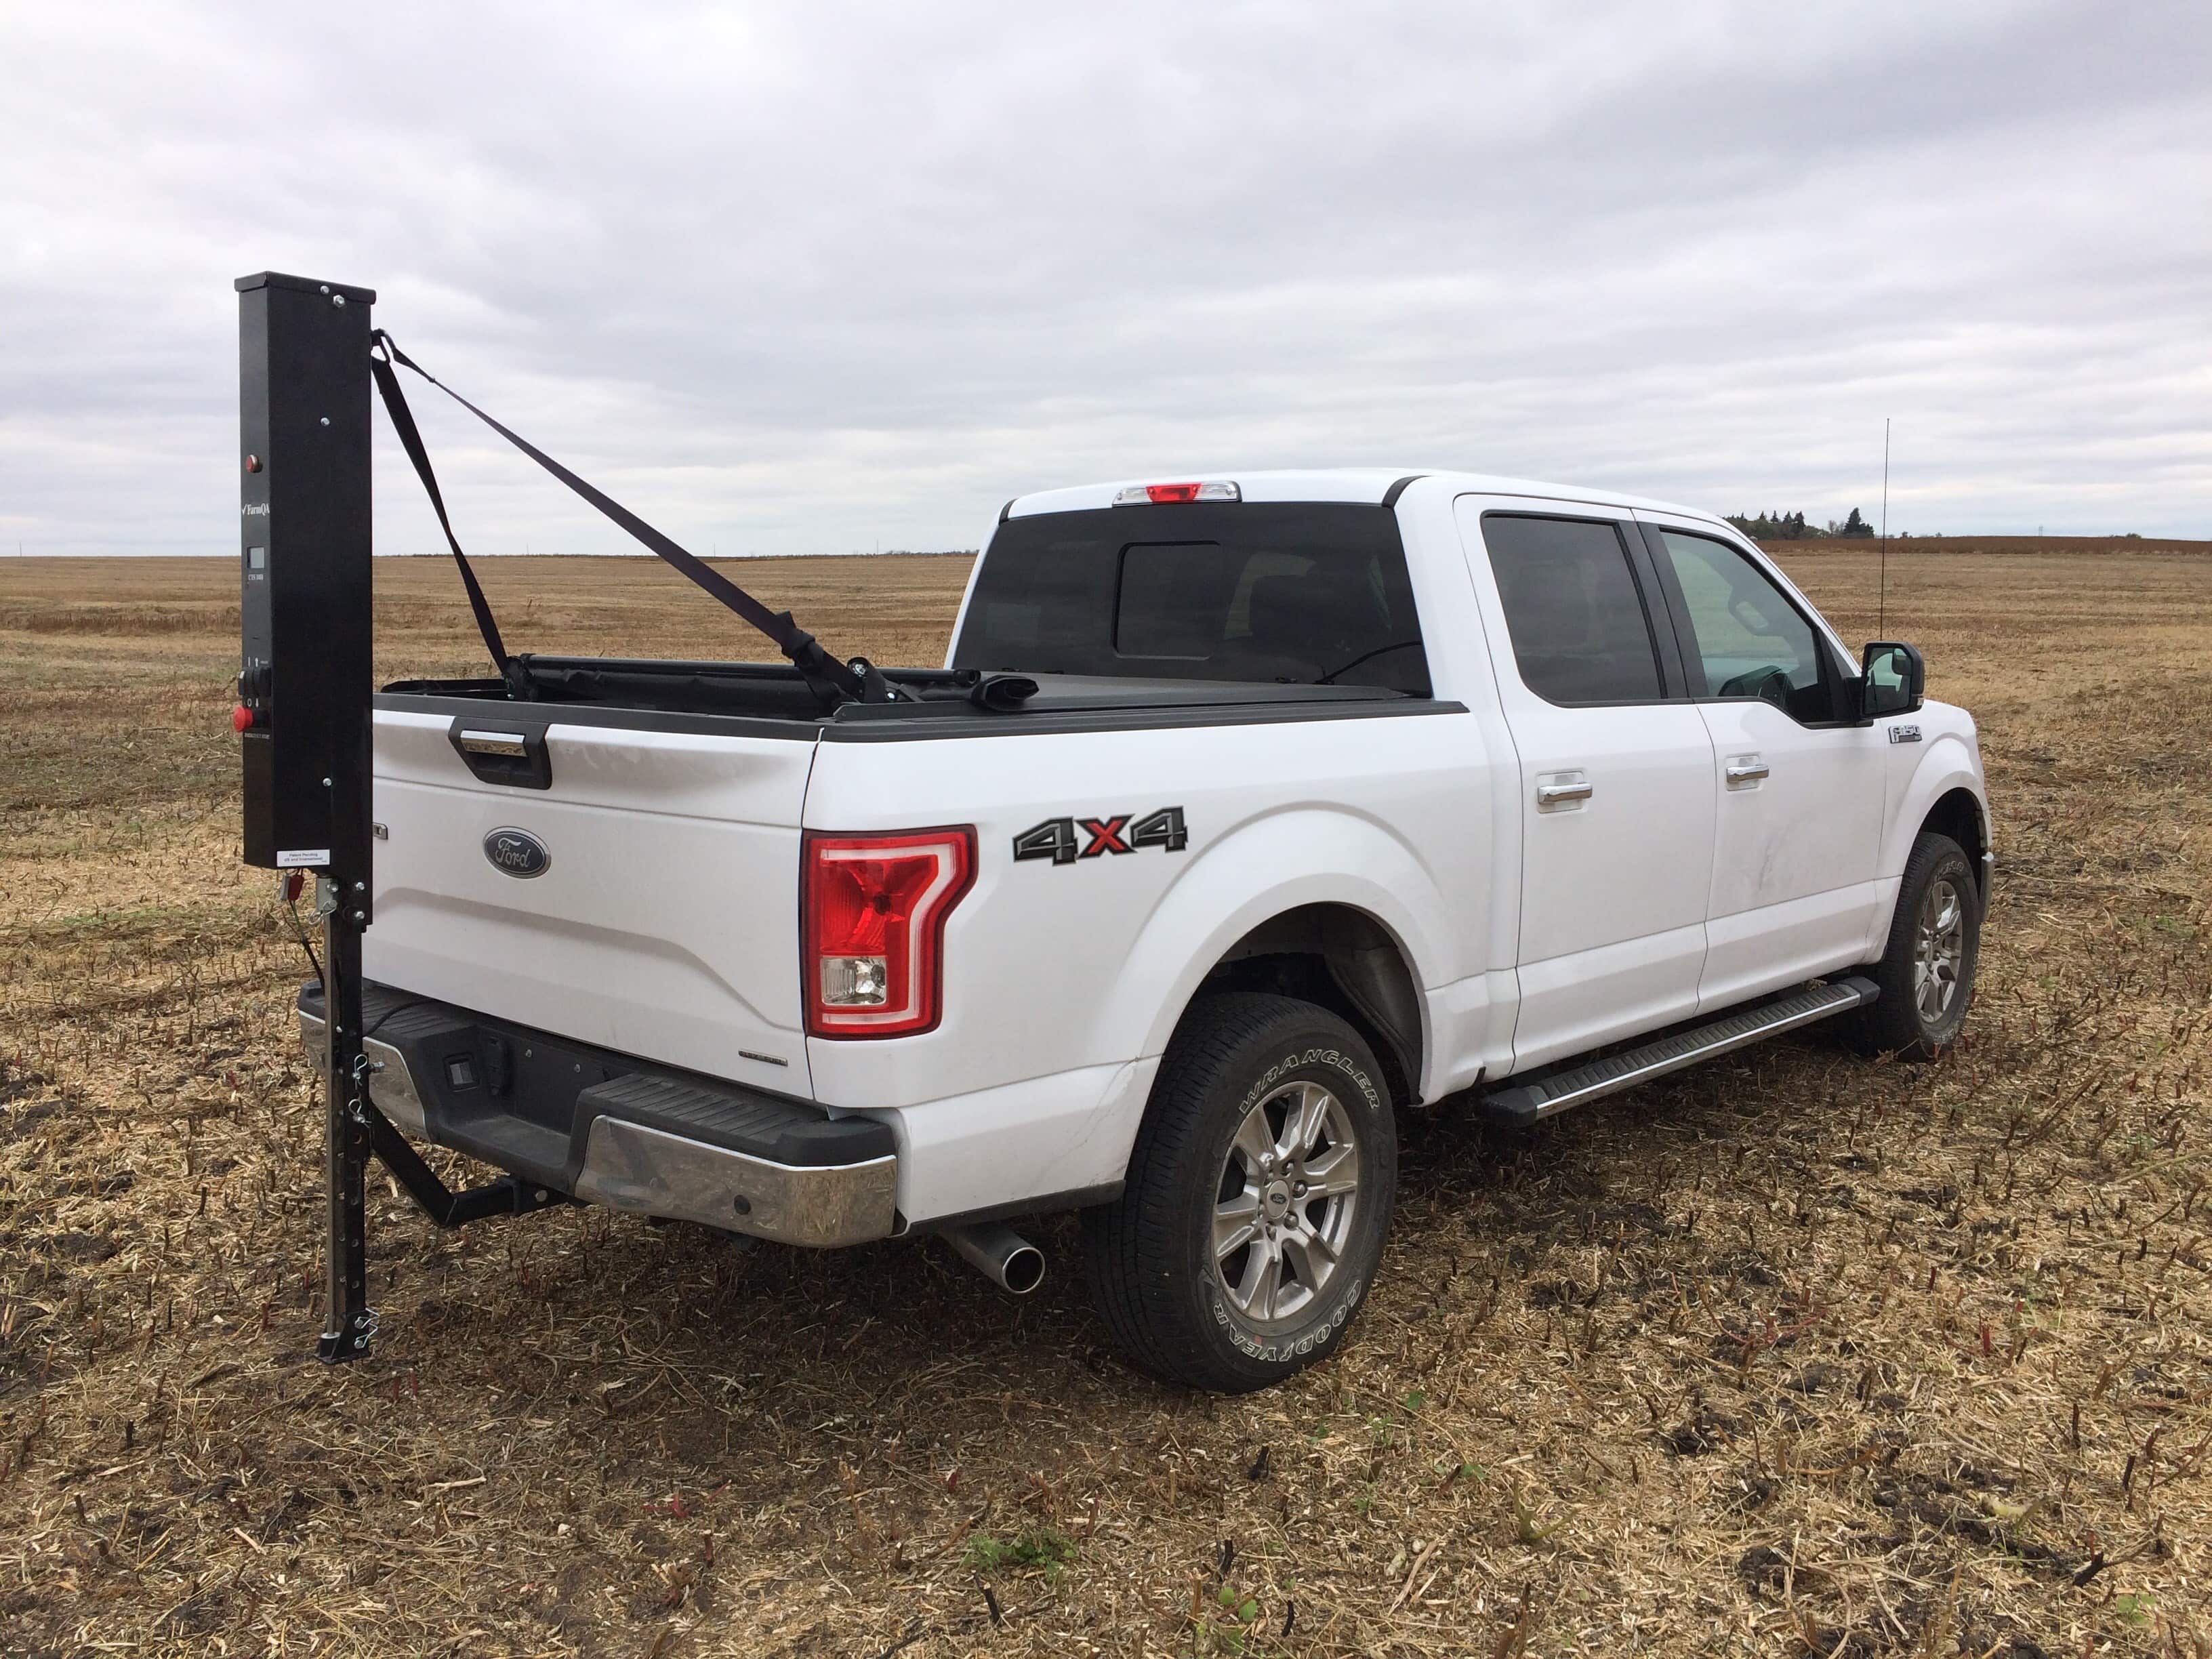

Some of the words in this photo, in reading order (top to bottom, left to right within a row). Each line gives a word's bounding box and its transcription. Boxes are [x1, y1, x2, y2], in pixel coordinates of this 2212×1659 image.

[494, 836, 532, 868] Ford
[1239, 1049, 1380, 1113] WRANGLER
[1213, 1279, 1361, 1362] GOODYEAR
